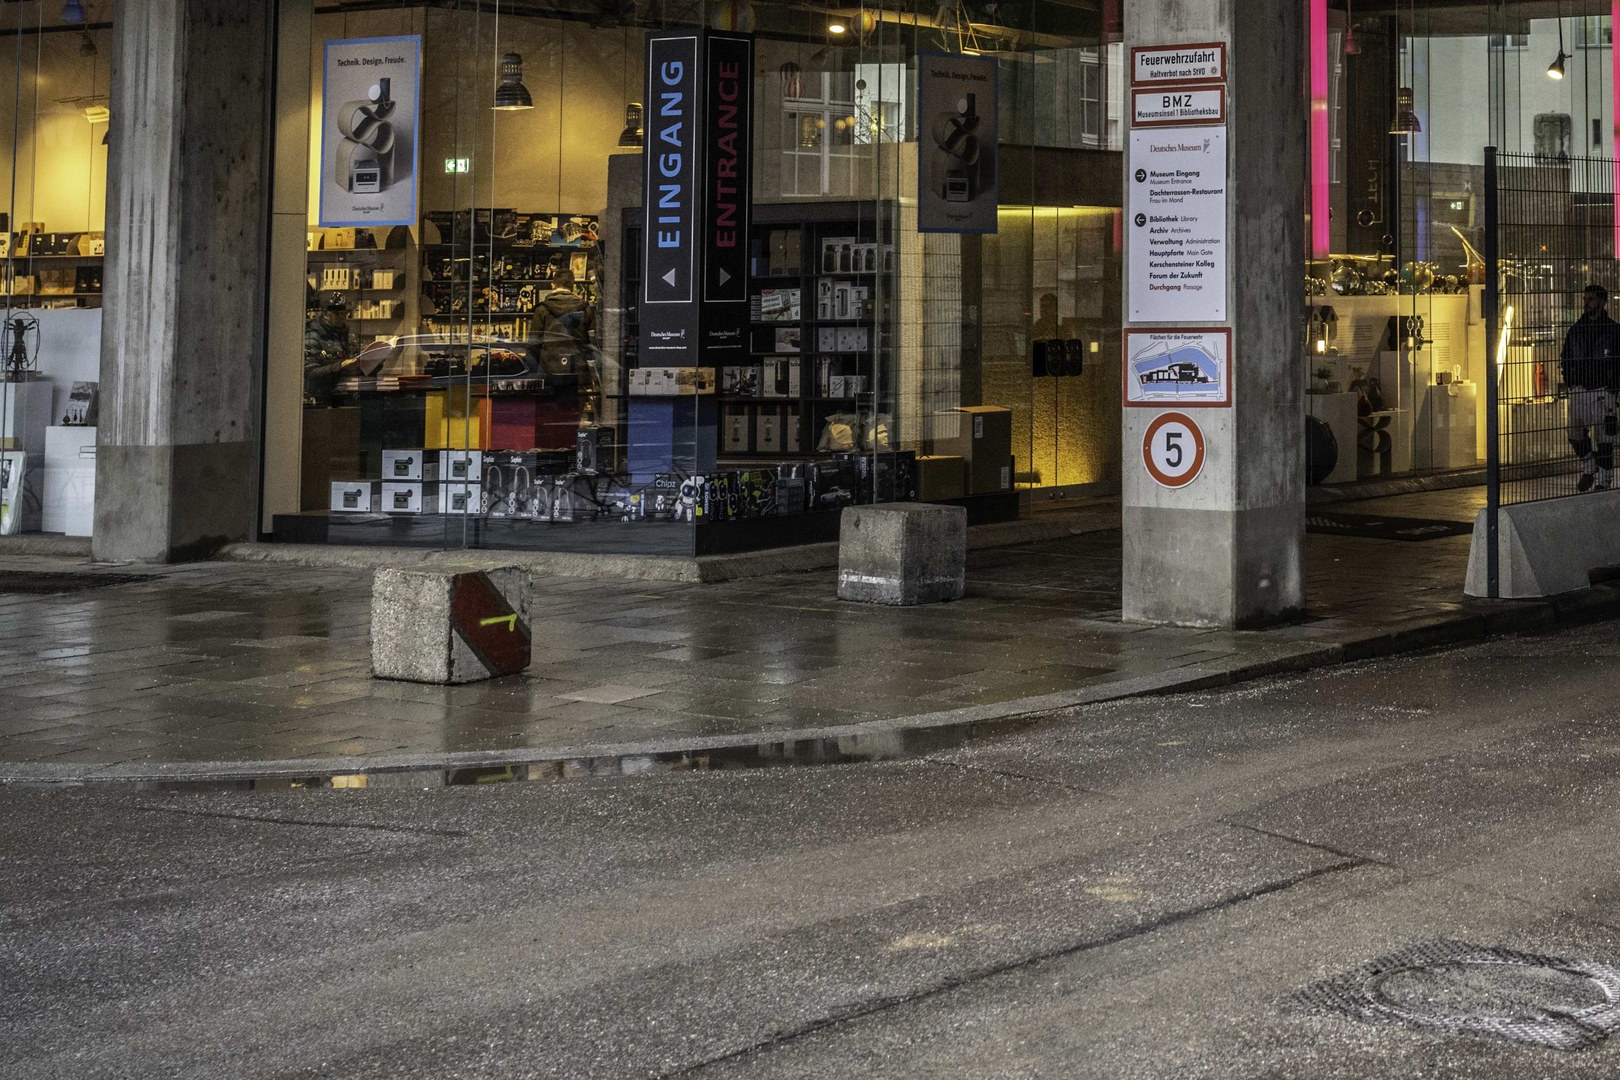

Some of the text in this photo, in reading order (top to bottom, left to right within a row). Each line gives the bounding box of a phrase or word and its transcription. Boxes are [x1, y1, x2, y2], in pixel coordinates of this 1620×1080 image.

[337, 58, 361, 67] Technik.
[362, 57, 384, 67] Design.
[1140, 51, 1215, 66] Feuerwehrzufahrt
[1150, 67, 1205, 78] Haltverbot nach StVO
[1162, 95, 1192, 108] BMZ
[1137, 109, 1175, 118] Museumsinsel
[1180, 107, 1218, 117] Bibliotheksbau
[1150, 143, 1202, 153] Deutsches Museum
[658, 61, 683, 248] EINGANG
[716, 61, 739, 247] ENTRANCE
[1150, 170, 1200, 178] Museum Eingang
[1149, 188, 1223, 197] Dachterrassen-Restaurant
[1149, 215, 1178, 223] Bibliothek
[1149, 238, 1183, 246] Verwaltung
[1149, 249, 1184, 257] Hauptpforte
[1195, 260, 1215, 268] Kolleg
[1180, 271, 1203, 279] Zukunft
[1149, 283, 1203, 291] Durchgang Passage
[1165, 432, 1183, 468] 5
[655, 479, 676, 488] Chipz
